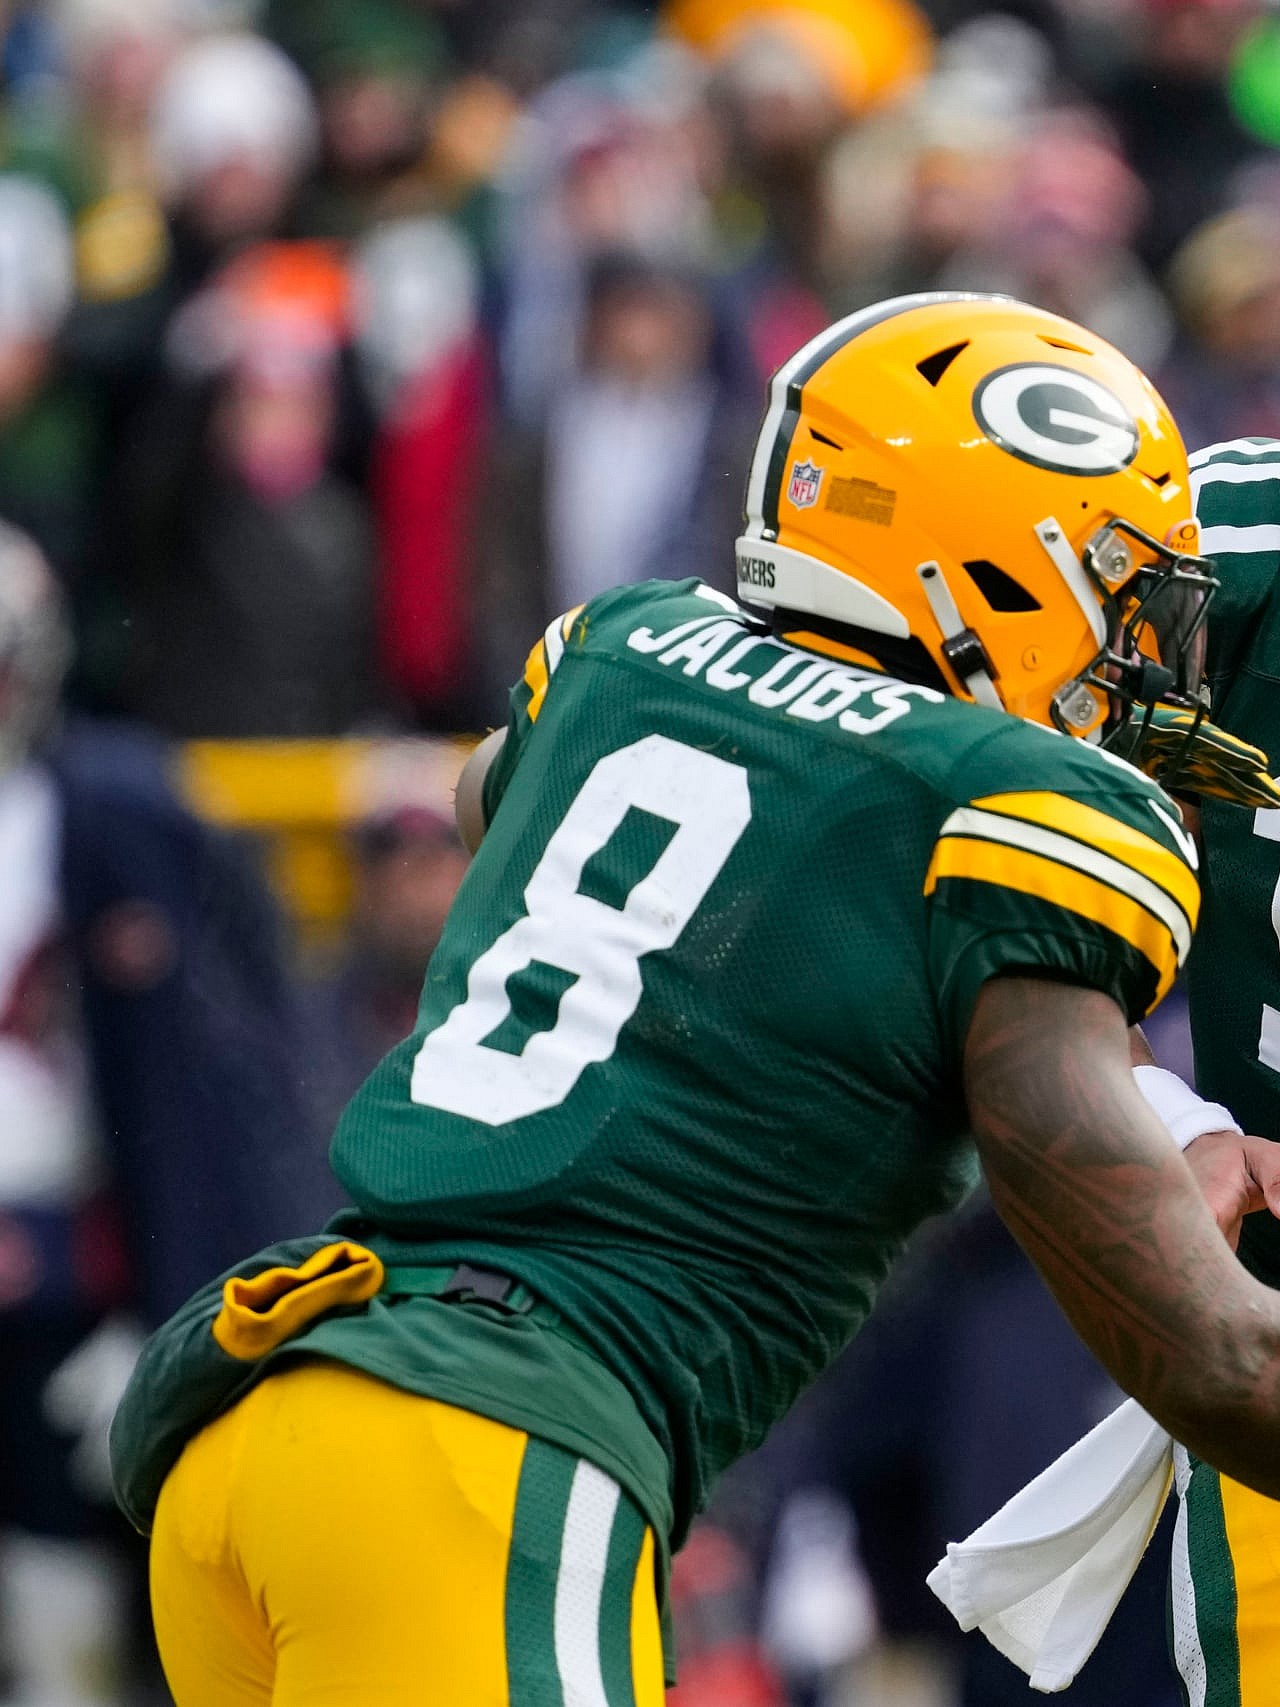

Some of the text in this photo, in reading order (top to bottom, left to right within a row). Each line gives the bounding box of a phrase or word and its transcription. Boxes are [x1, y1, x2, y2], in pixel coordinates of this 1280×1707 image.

[979, 364, 1139, 473] G
[792, 480, 814, 502] NFL
[627, 614, 945, 735] JACOBS
[411, 733, 752, 1127] 8
